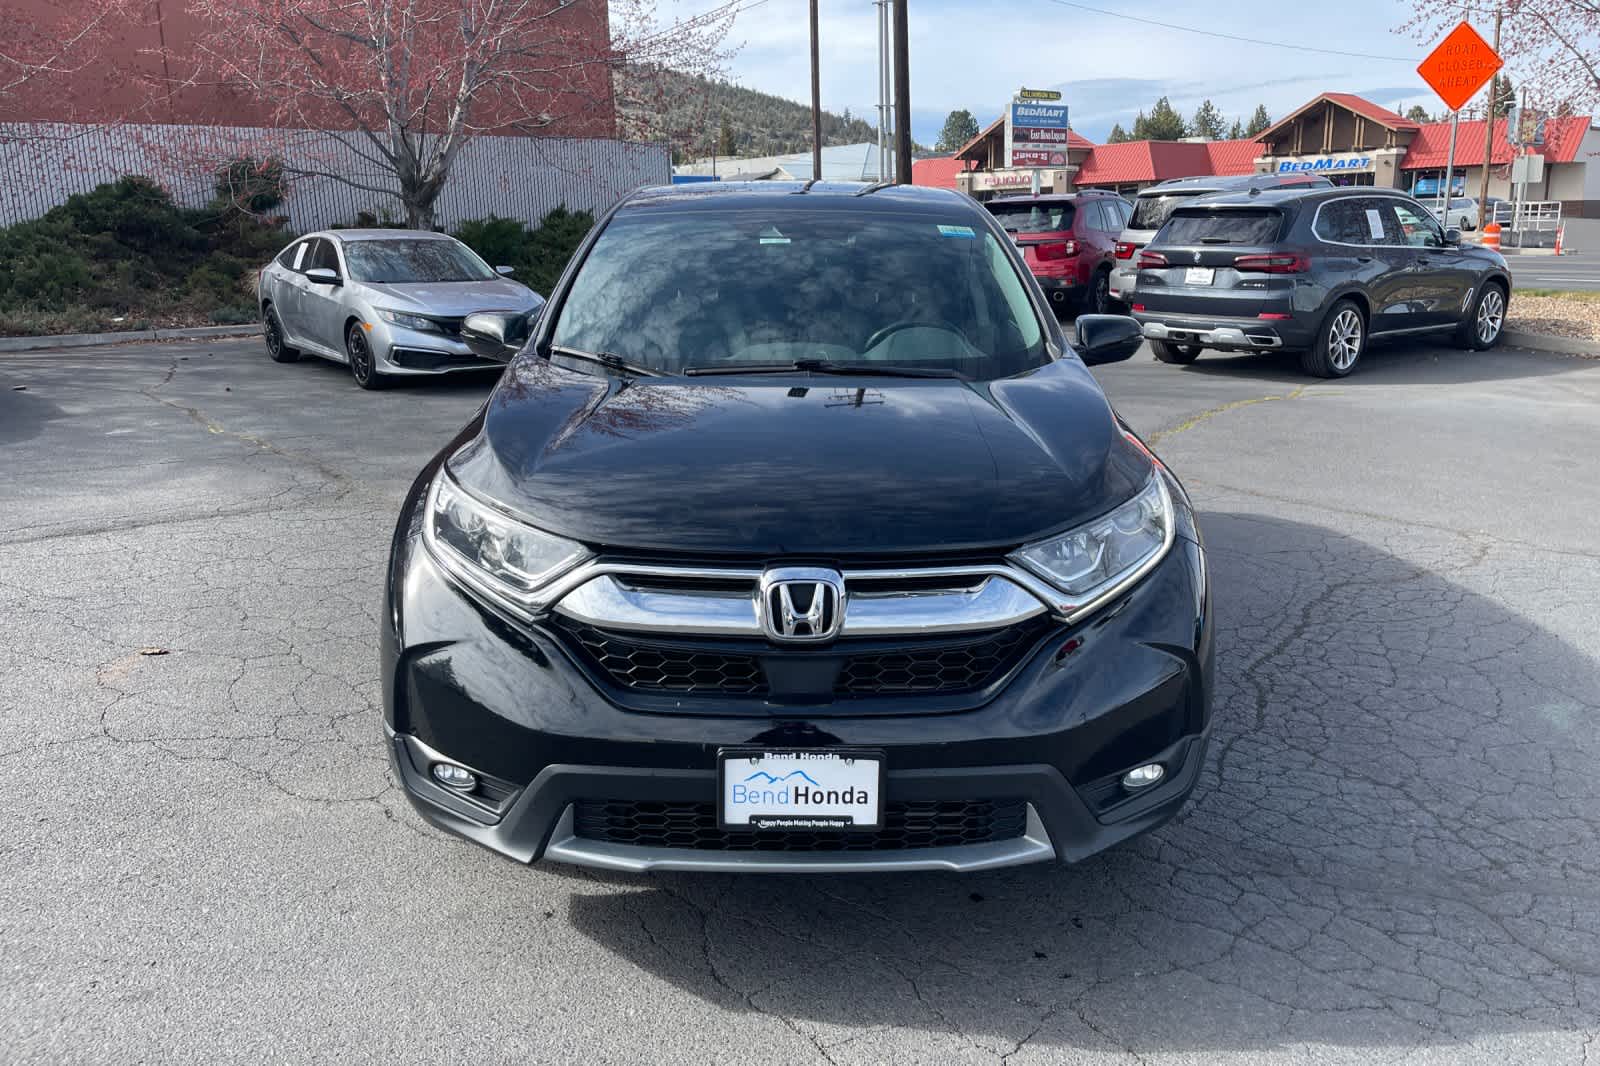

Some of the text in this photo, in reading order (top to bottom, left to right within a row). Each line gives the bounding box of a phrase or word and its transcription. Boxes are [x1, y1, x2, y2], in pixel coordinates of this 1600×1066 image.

[1446, 43, 1479, 55] ROAD
[1438, 60, 1483, 72] CLOSED
[1439, 76, 1479, 88] AHEAD
[763, 752, 840, 760] Bend Honda
[732, 784, 869, 805] Bend Honda
